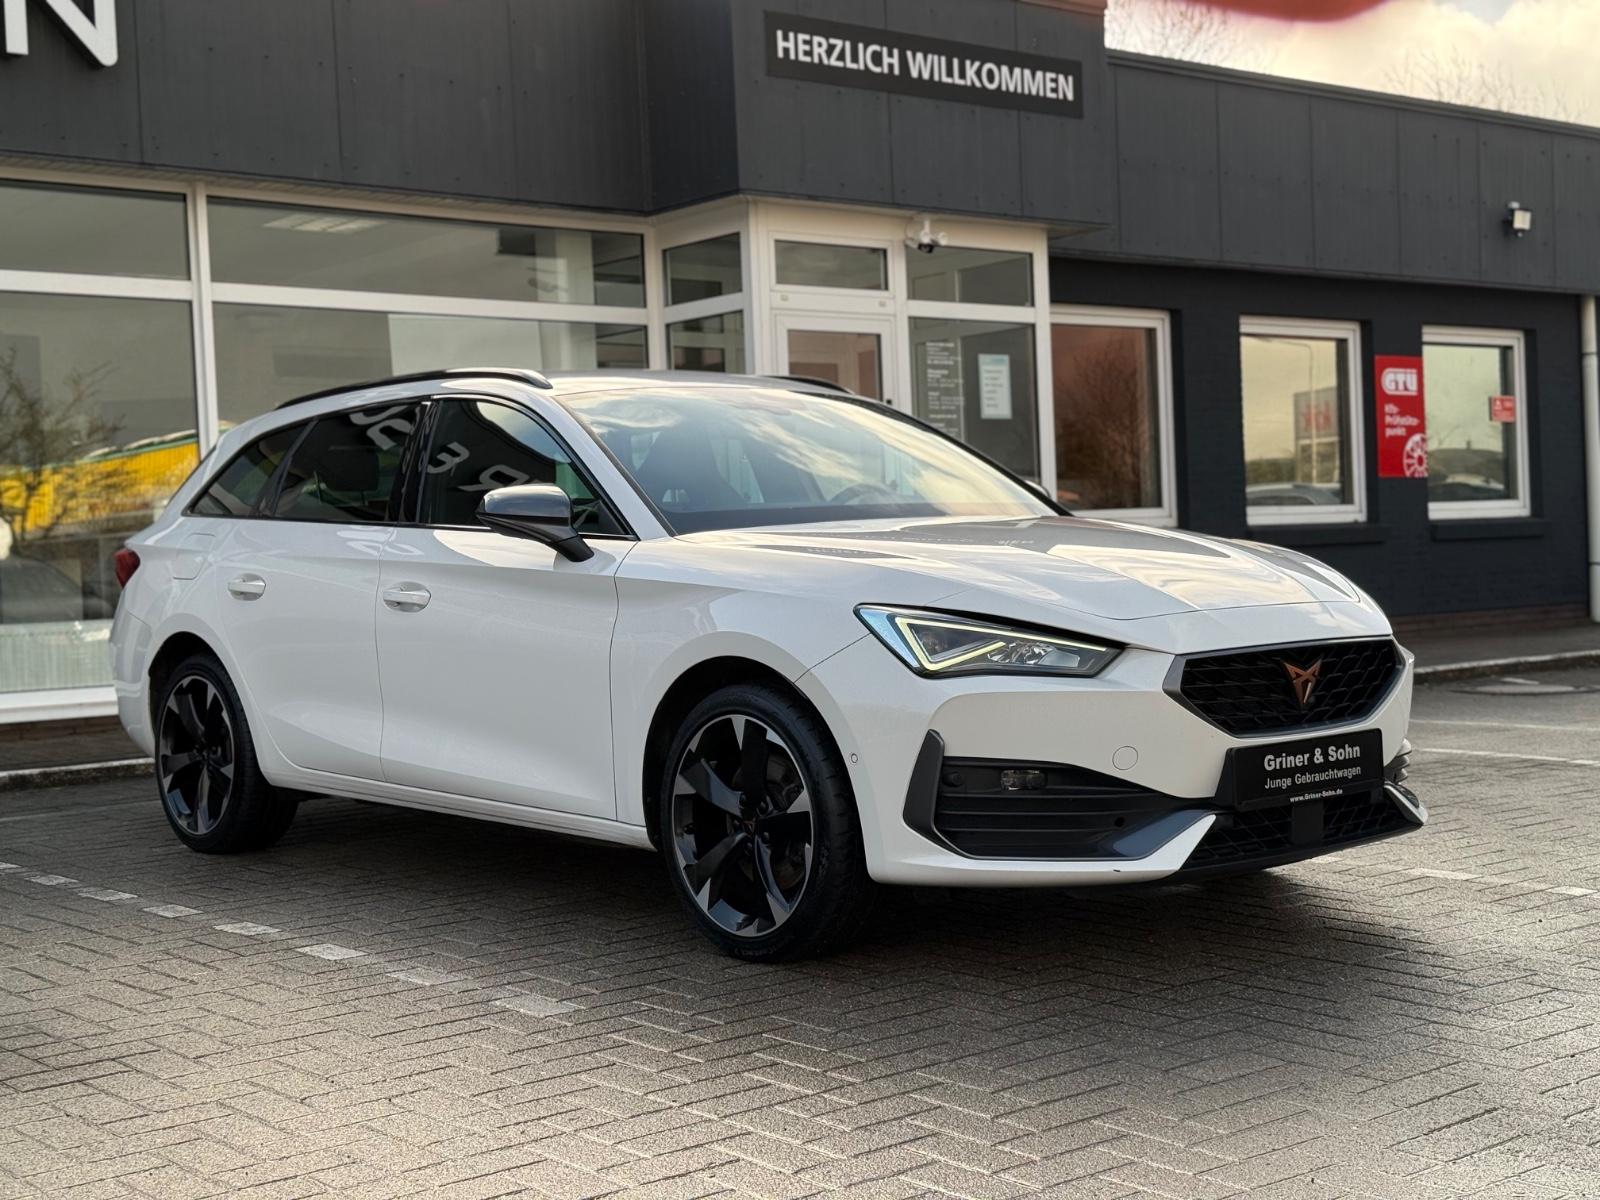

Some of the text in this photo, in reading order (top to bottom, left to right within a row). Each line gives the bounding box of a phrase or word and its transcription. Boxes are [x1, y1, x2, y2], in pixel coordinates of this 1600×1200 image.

[776, 29, 1074, 101] HERZLICH WILLKOMMEN
[1264, 744, 1361, 771] Griner & Sohn
[1264, 766, 1361, 790] Junge Gebrauchtwagen
[1289, 788, 1343, 803] www.Griner-Sohn.de
